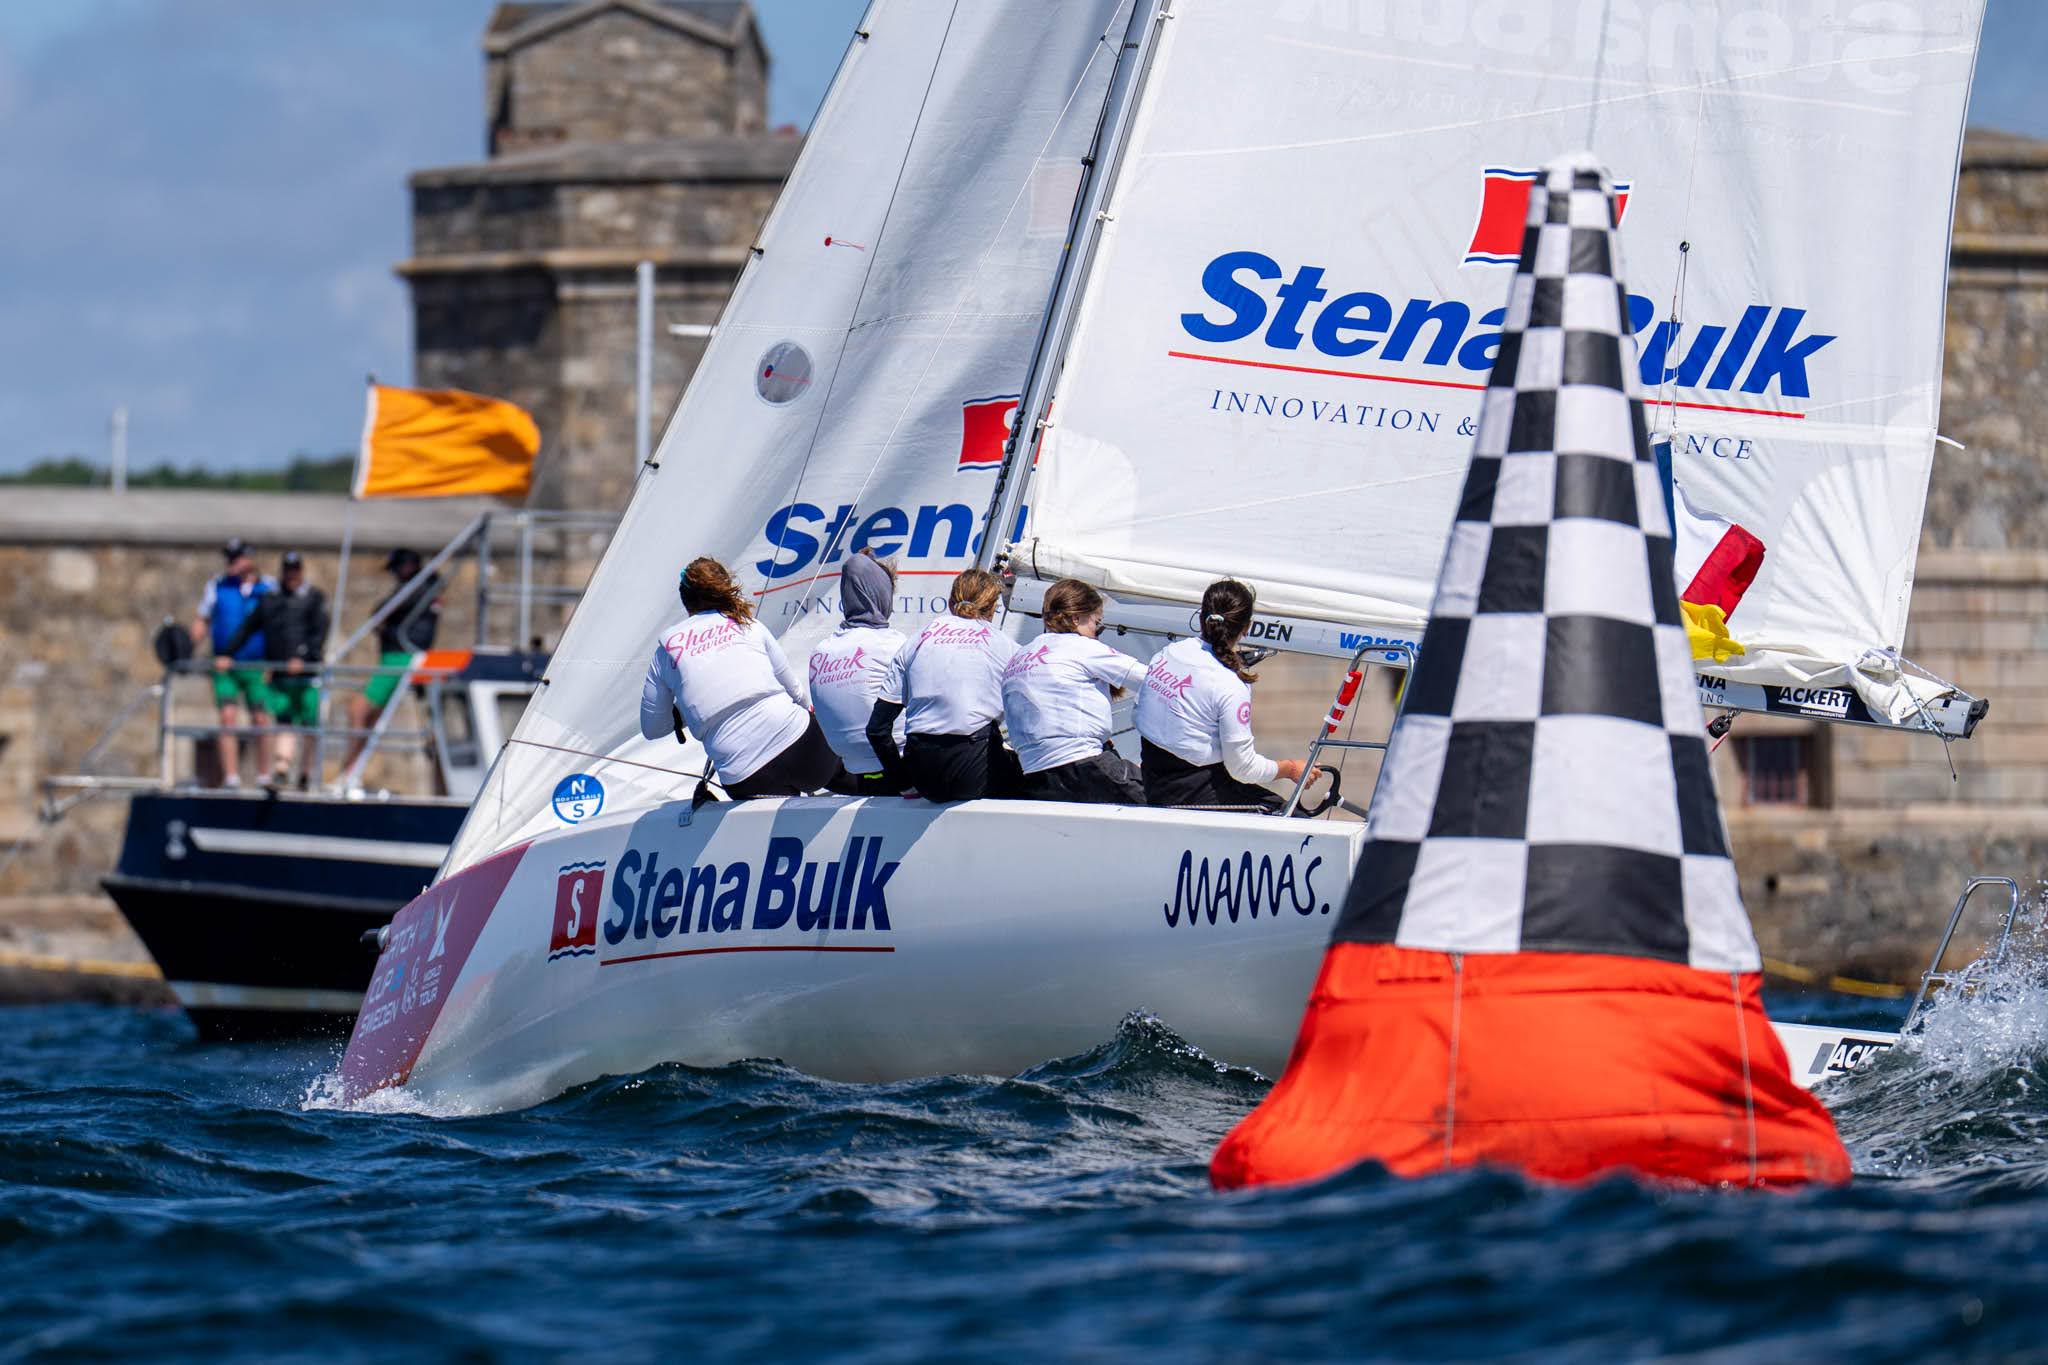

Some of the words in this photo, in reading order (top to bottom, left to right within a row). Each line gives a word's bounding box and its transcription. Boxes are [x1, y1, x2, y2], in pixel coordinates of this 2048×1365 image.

[1626, 293, 1838, 398] ulk
[1210, 389, 1441, 433] INNOVATION
[1457, 416, 1478, 436] &
[934, 635, 983, 646] caviar
[1247, 620, 1293, 642] DÉN
[665, 617, 745, 669] Shark
[690, 633, 736, 657] caviar
[809, 647, 865, 684] Shark
[819, 668, 857, 685] caviar
[1779, 687, 1853, 708] ACKERT
[571, 779, 586, 795] N
[555, 795, 580, 803] NORTH
[573, 803, 585, 818] S
[567, 878, 584, 939] S
[603, 849, 750, 945] Stena
[752, 836, 901, 932] Bulk
